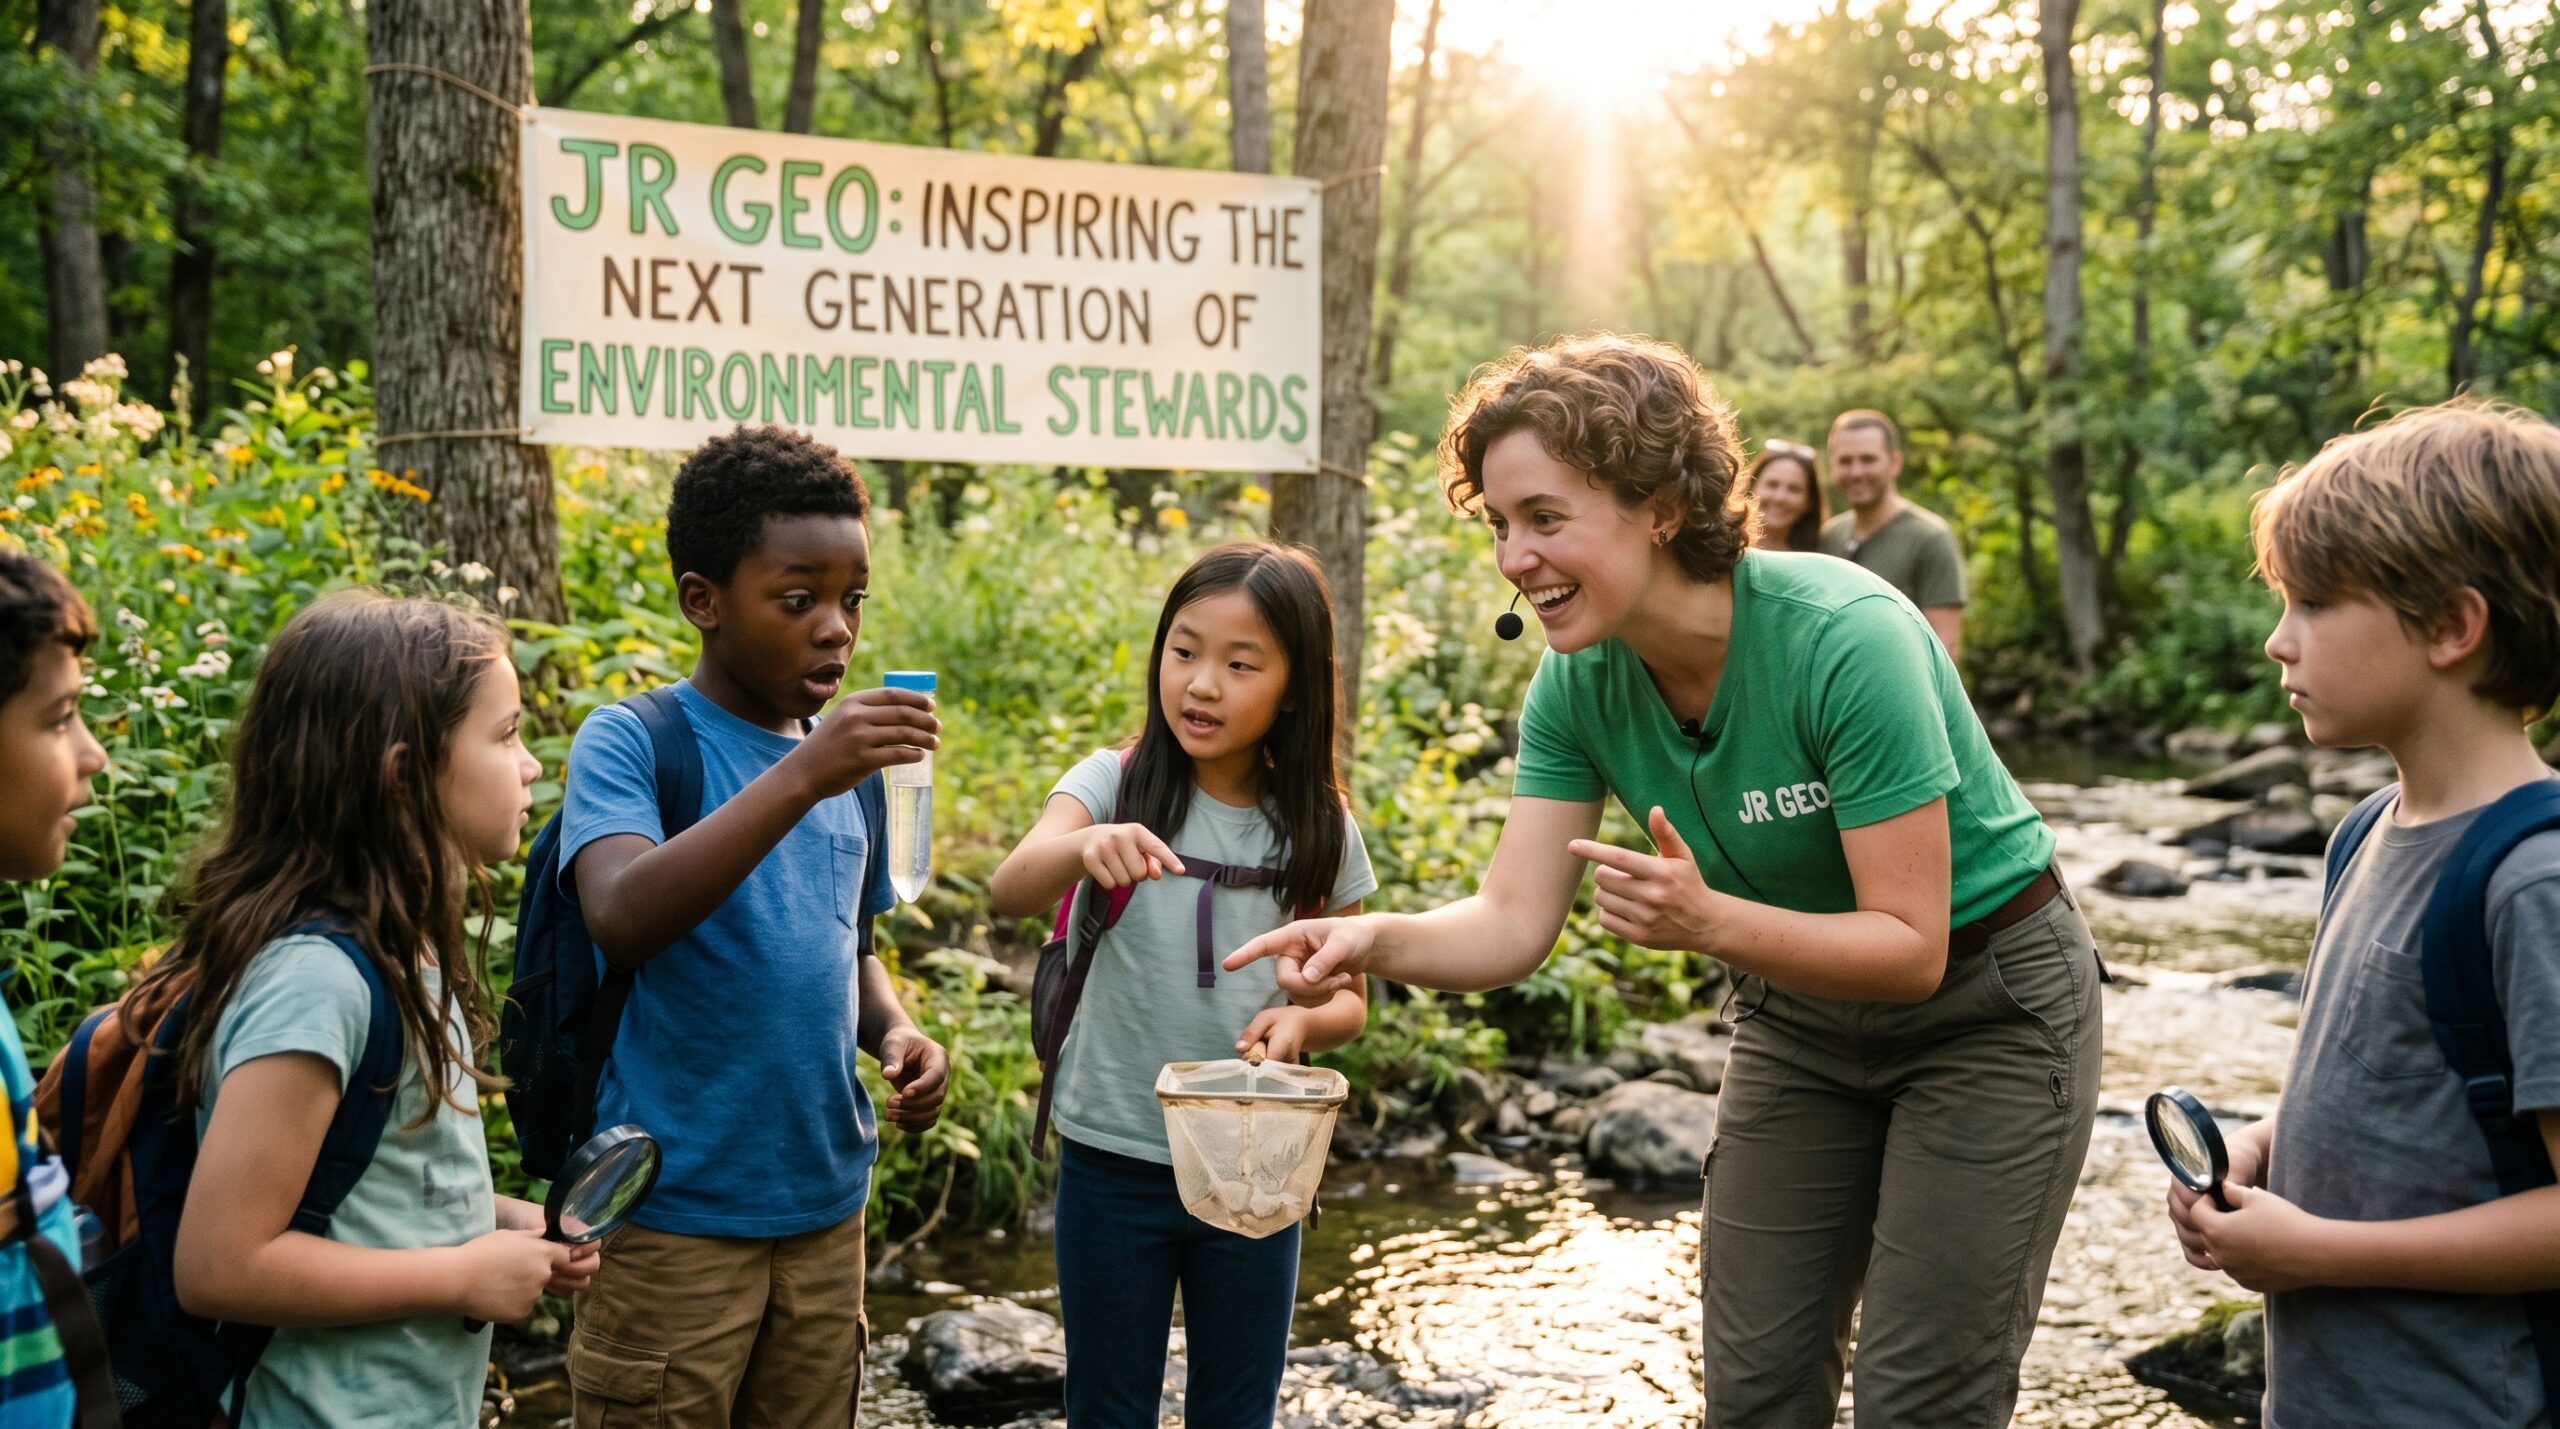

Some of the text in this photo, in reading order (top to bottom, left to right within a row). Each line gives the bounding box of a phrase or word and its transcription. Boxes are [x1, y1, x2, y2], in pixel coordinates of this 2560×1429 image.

[551, 138, 1305, 268] JR GEO: INSPIRING THE
[603, 257, 1257, 350] NEXT GENERATION OF
[540, 338, 1307, 444] ENVIRONMENTAL STEWARDS
[1738, 781, 1831, 824] JR GEO
